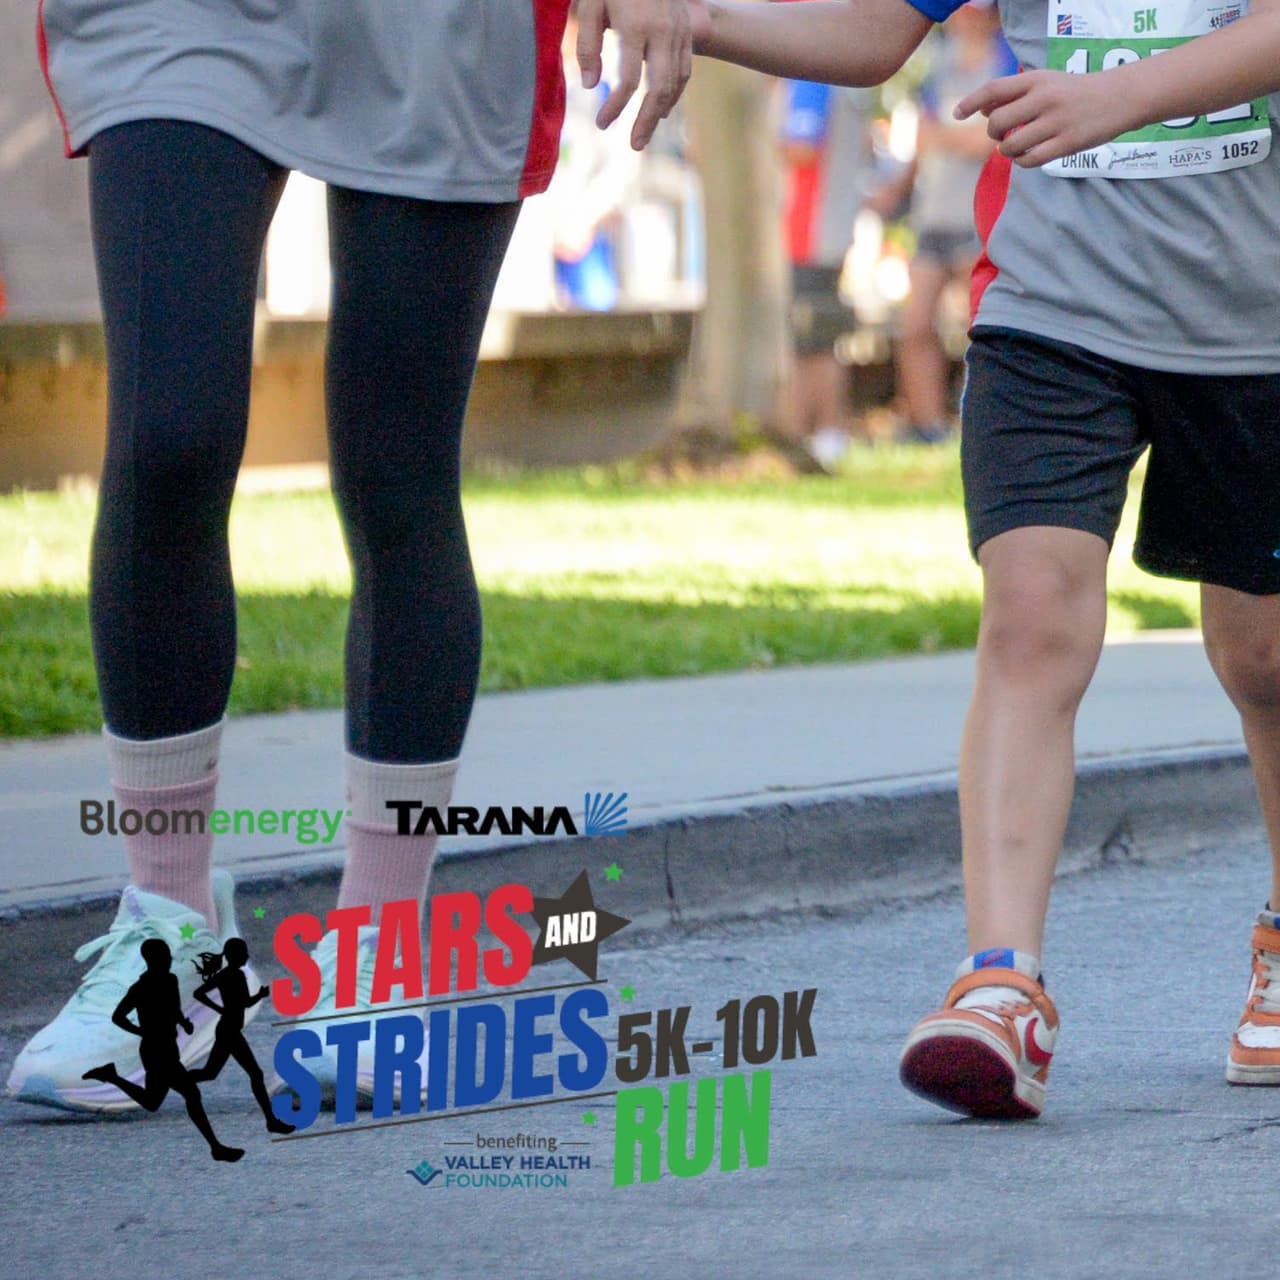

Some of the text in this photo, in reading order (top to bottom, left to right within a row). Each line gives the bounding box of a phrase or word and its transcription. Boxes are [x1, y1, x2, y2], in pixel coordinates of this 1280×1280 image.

[1134, 8, 1157, 33] 5K
[1222, 140, 1259, 160] 1052
[1062, 153, 1099, 168] DRINK
